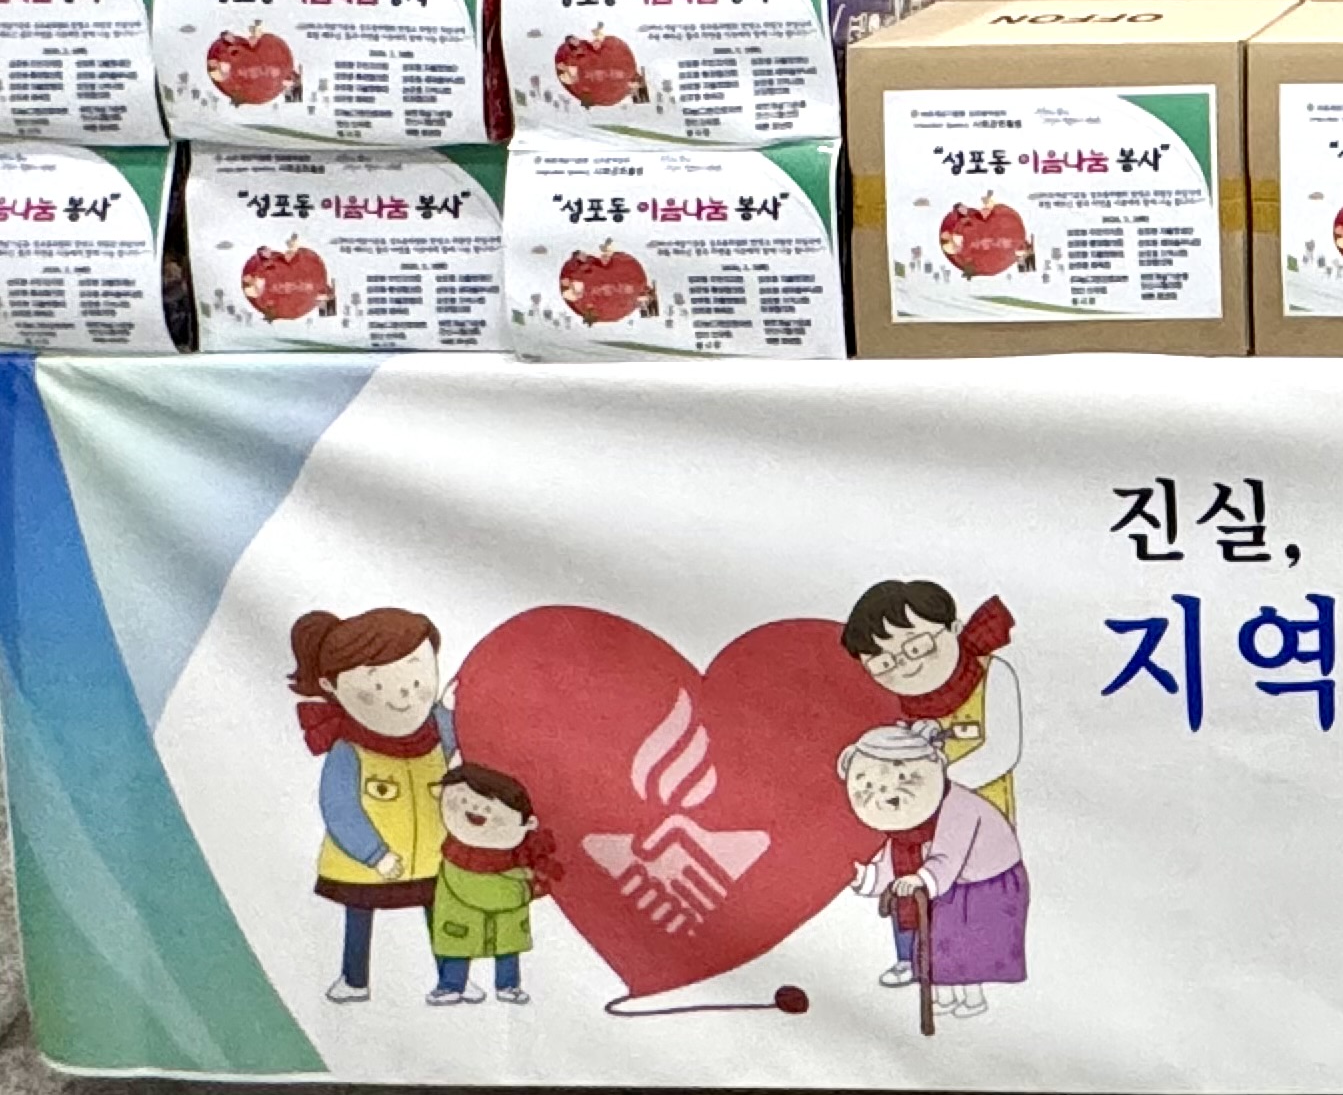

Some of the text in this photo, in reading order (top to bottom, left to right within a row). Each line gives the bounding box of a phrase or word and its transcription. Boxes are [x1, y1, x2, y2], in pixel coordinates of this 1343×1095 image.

[990, 13, 1166, 27] OFFON
[1019, 150, 1109, 174] 이음나눔
[321, 195, 409, 220] 이음나눔
[637, 198, 728, 222] 이음나눔
[1110, 477, 1304, 568] 진실,
